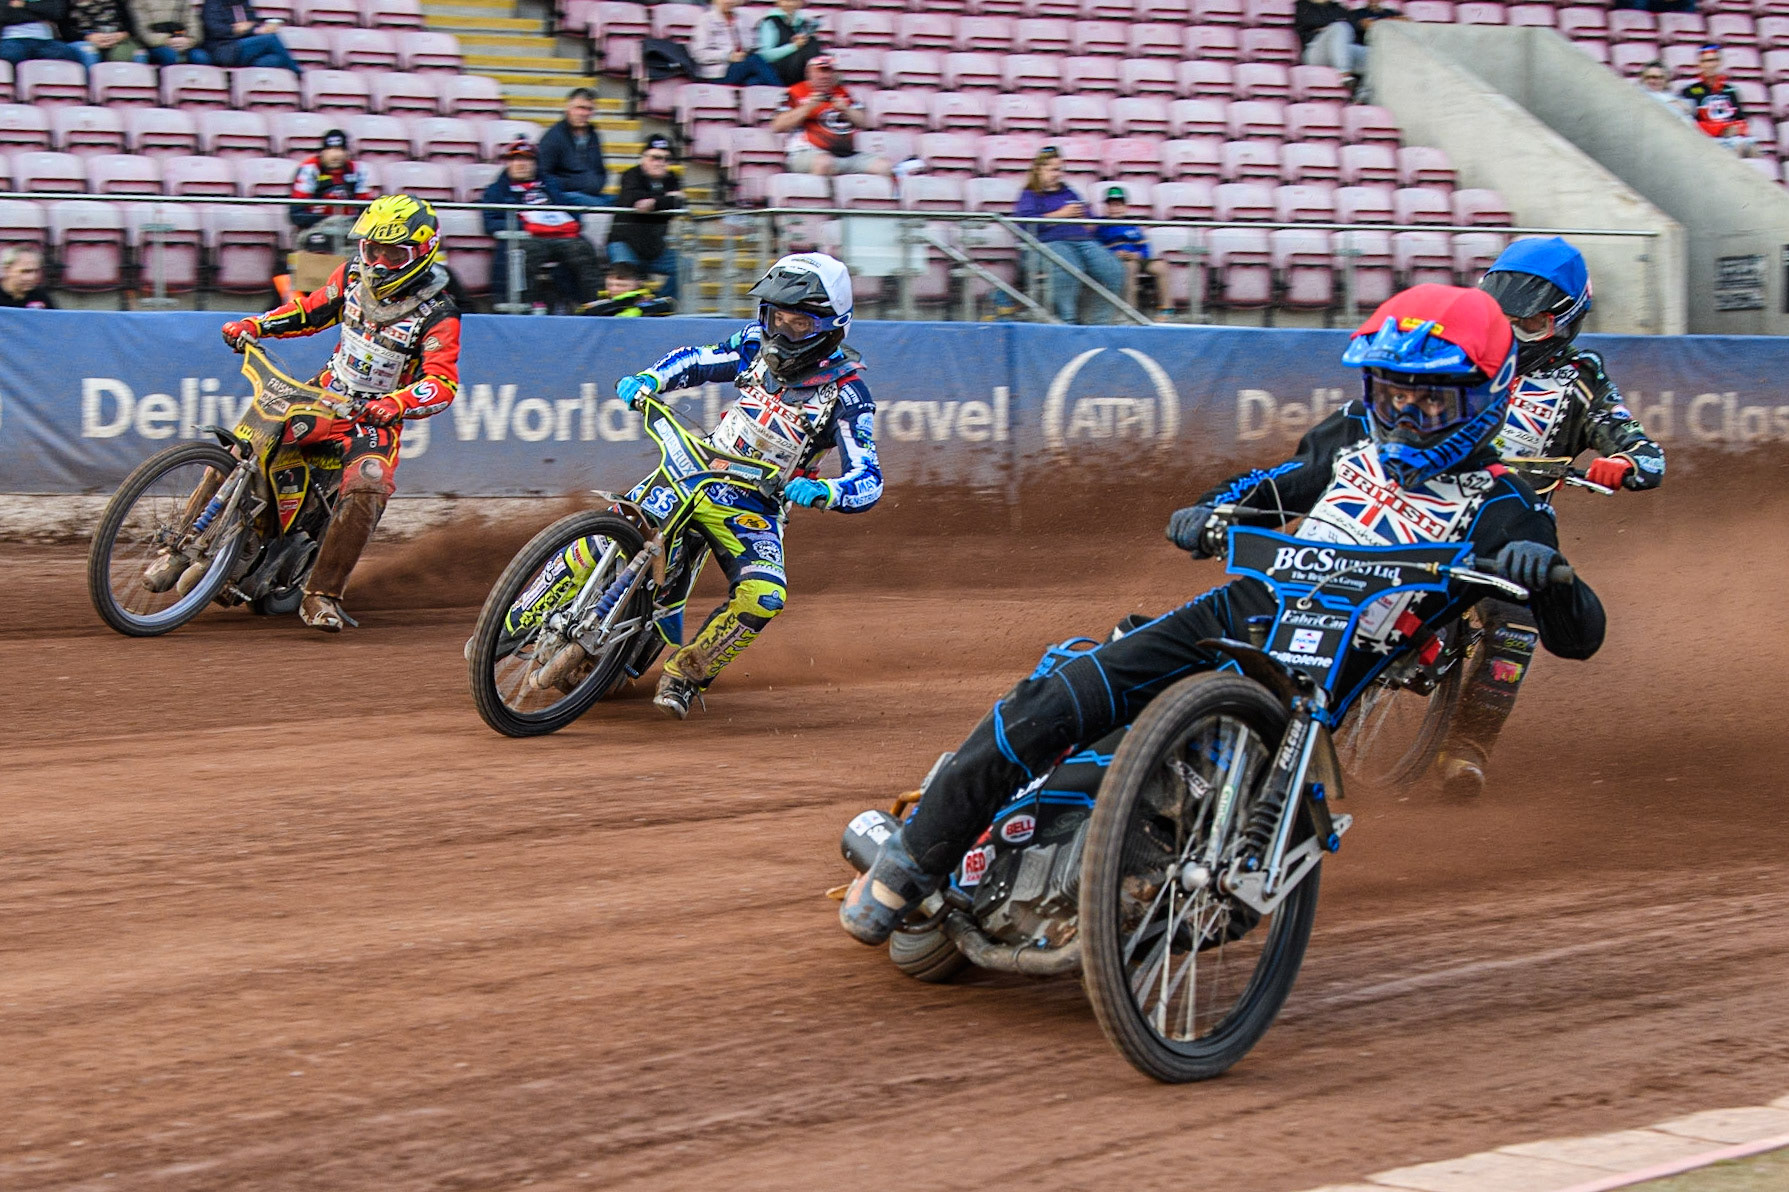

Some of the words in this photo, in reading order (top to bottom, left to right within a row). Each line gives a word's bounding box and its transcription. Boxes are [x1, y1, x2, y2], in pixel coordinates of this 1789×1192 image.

[261, 393, 287, 411] RAING
[371, 404, 393, 420] FOX
[872, 385, 1011, 442] ravel
[775, 436, 798, 451] 2023
[673, 449, 698, 477] FLUX
[1337, 464, 1447, 540] BRITISH
[1273, 546, 1336, 572] BCS
[1374, 564, 1402, 580] Ltd
[1280, 609, 1349, 630] FabriCan
[1279, 718, 1304, 771] FALCON
[1005, 819, 1035, 836] BELL
[965, 852, 987, 874] RED
